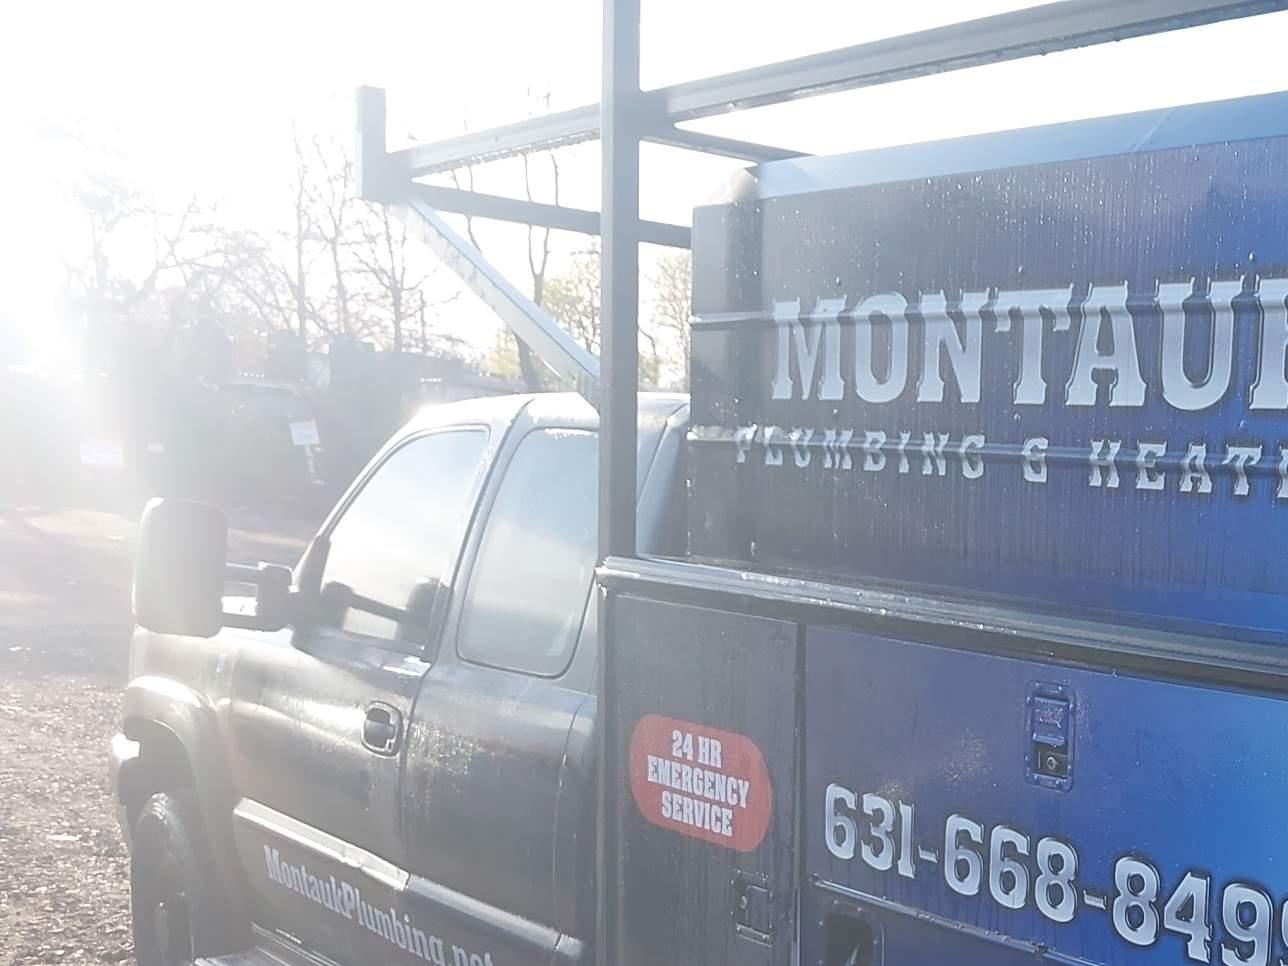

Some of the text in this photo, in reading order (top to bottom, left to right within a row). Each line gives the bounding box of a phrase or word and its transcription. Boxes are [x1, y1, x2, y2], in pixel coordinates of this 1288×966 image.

[734, 424, 986, 480] PLUMBING
[672, 729, 722, 769] 24 HR
[647, 754, 750, 808] EMERGENCY
[661, 790, 733, 837] SERVICE
